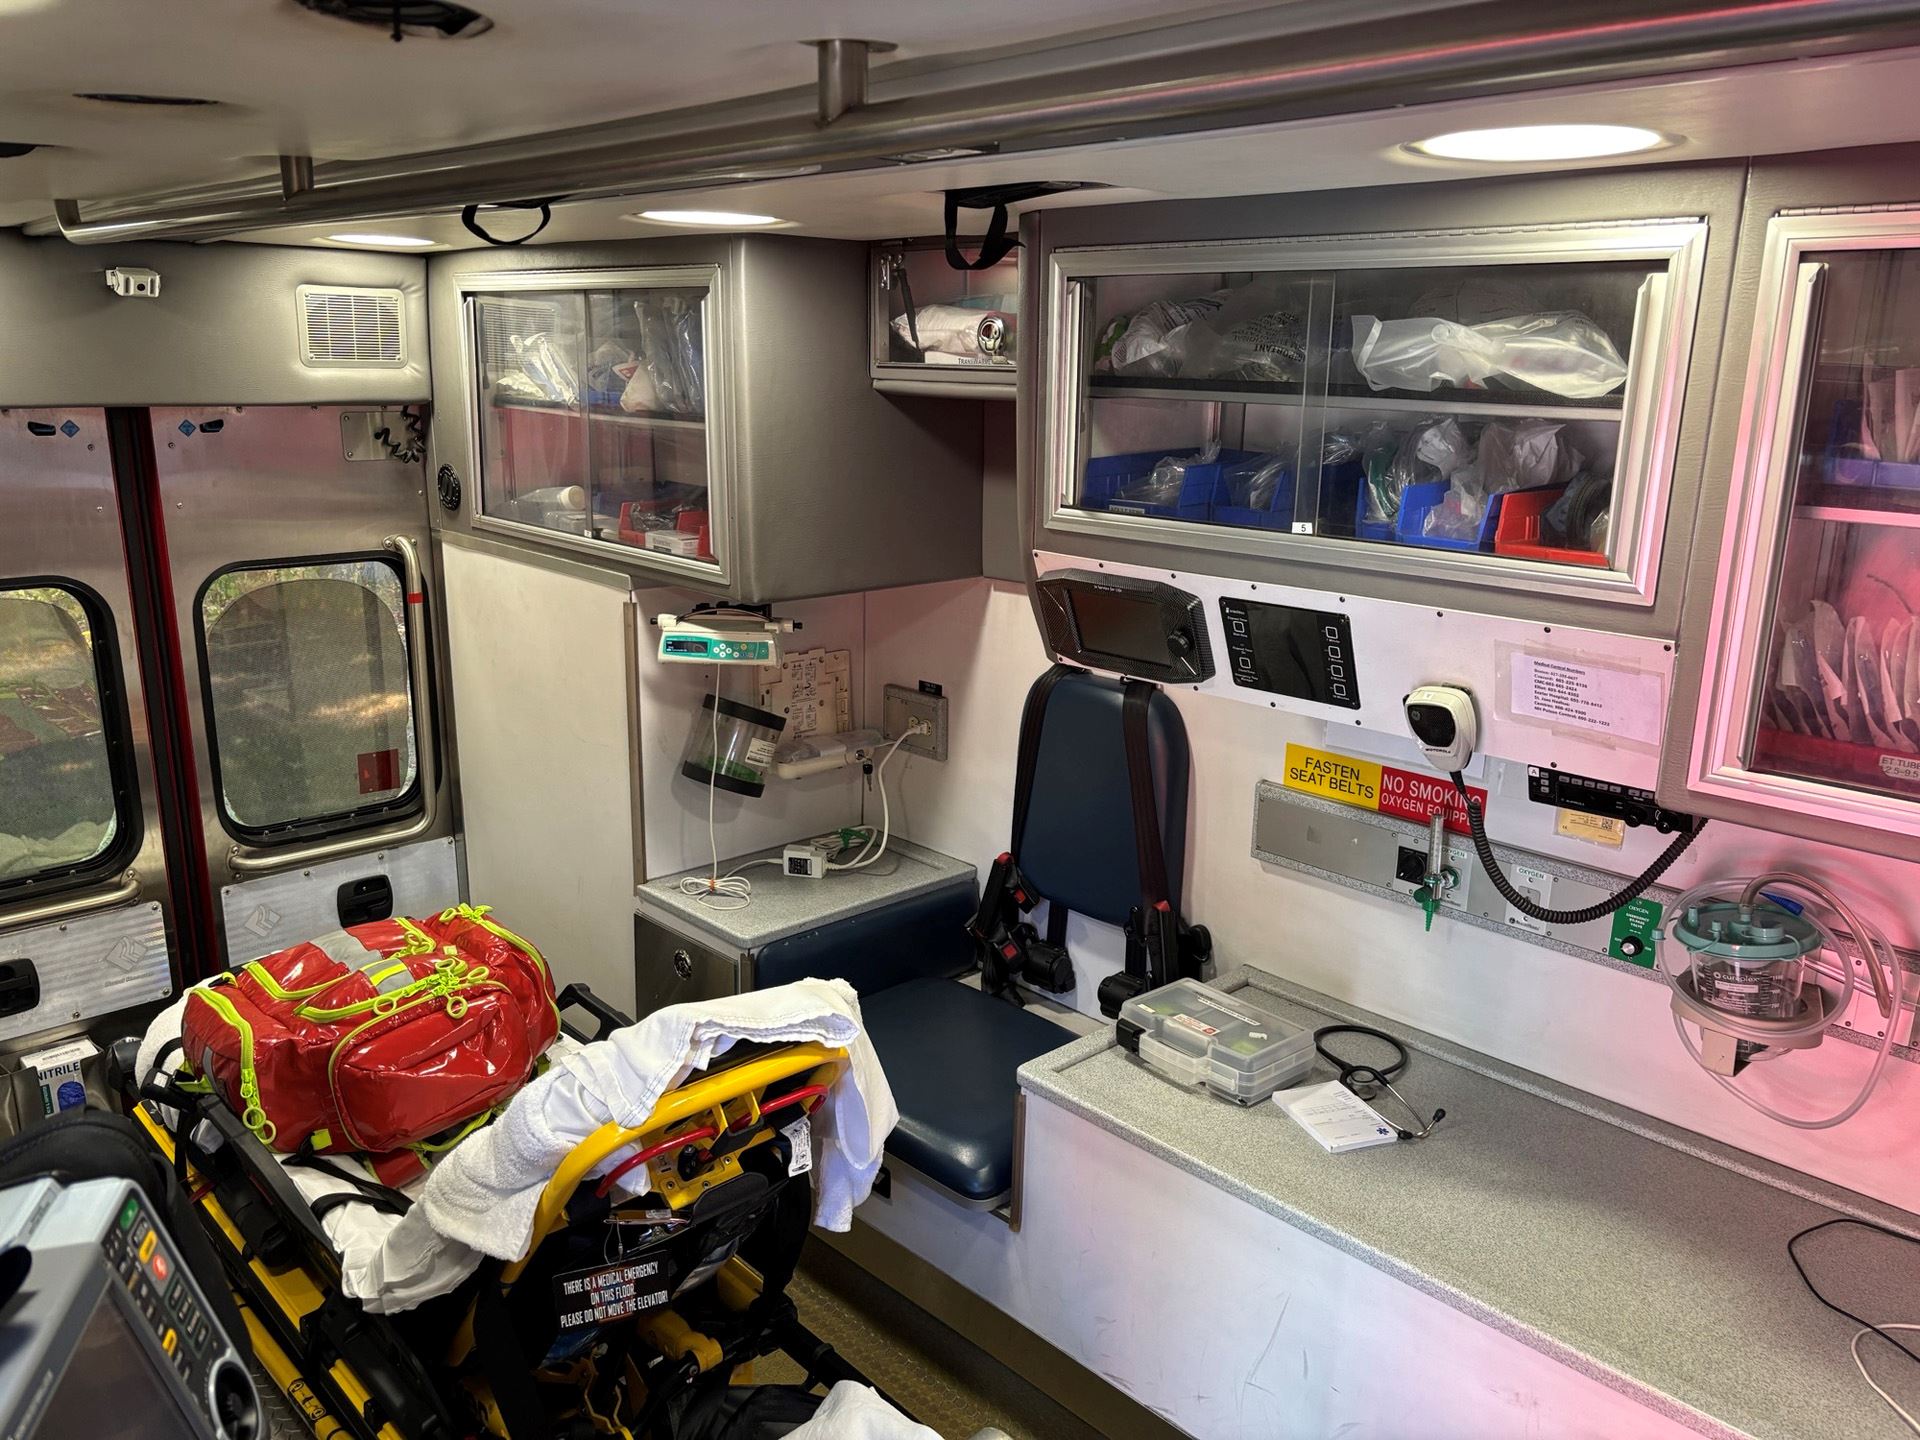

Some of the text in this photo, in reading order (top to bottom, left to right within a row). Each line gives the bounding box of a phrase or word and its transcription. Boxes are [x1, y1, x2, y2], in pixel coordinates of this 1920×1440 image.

[1301, 523, 1307, 533] 5
[1305, 757, 1360, 781] FASTEN
[1882, 757, 1895, 765] ET
[1289, 767, 1375, 799] SEAT BELTS
[1383, 774, 1404, 793] NO
[1382, 793, 1424, 813] OXYGEN
[1518, 867, 1544, 879] OXYGEN
[1628, 905, 1649, 914] OXYGEN
[564, 1261, 659, 1295] THERE IS A MEDICAL EMERGENCY
[590, 1283, 637, 1305] ON THIS FLOOR.
[560, 1290, 669, 1328] PLEASE DO NOT MOVE THE ELEVATOR!
